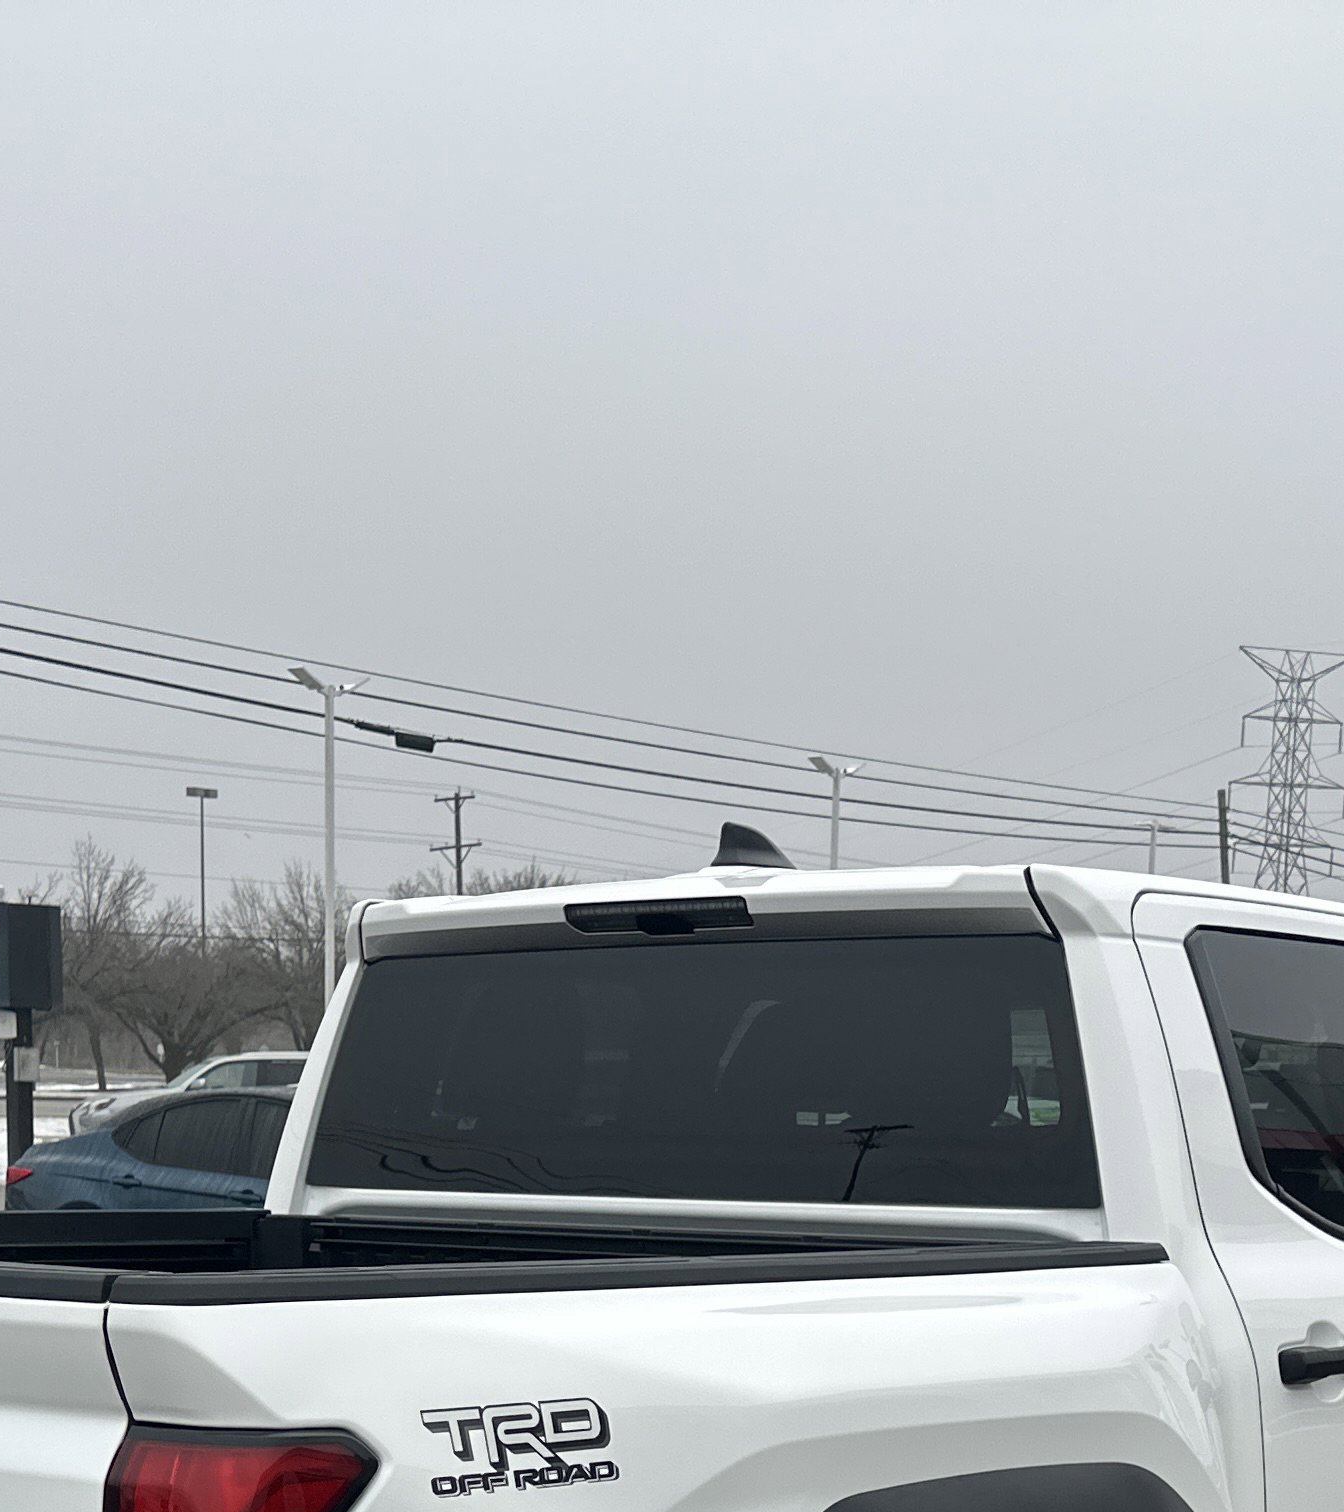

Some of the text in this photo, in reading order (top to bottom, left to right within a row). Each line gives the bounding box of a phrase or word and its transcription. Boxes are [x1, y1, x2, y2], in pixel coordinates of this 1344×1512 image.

[420, 1397, 611, 1471] TRD
[431, 1460, 620, 1498] OFF ROAD
